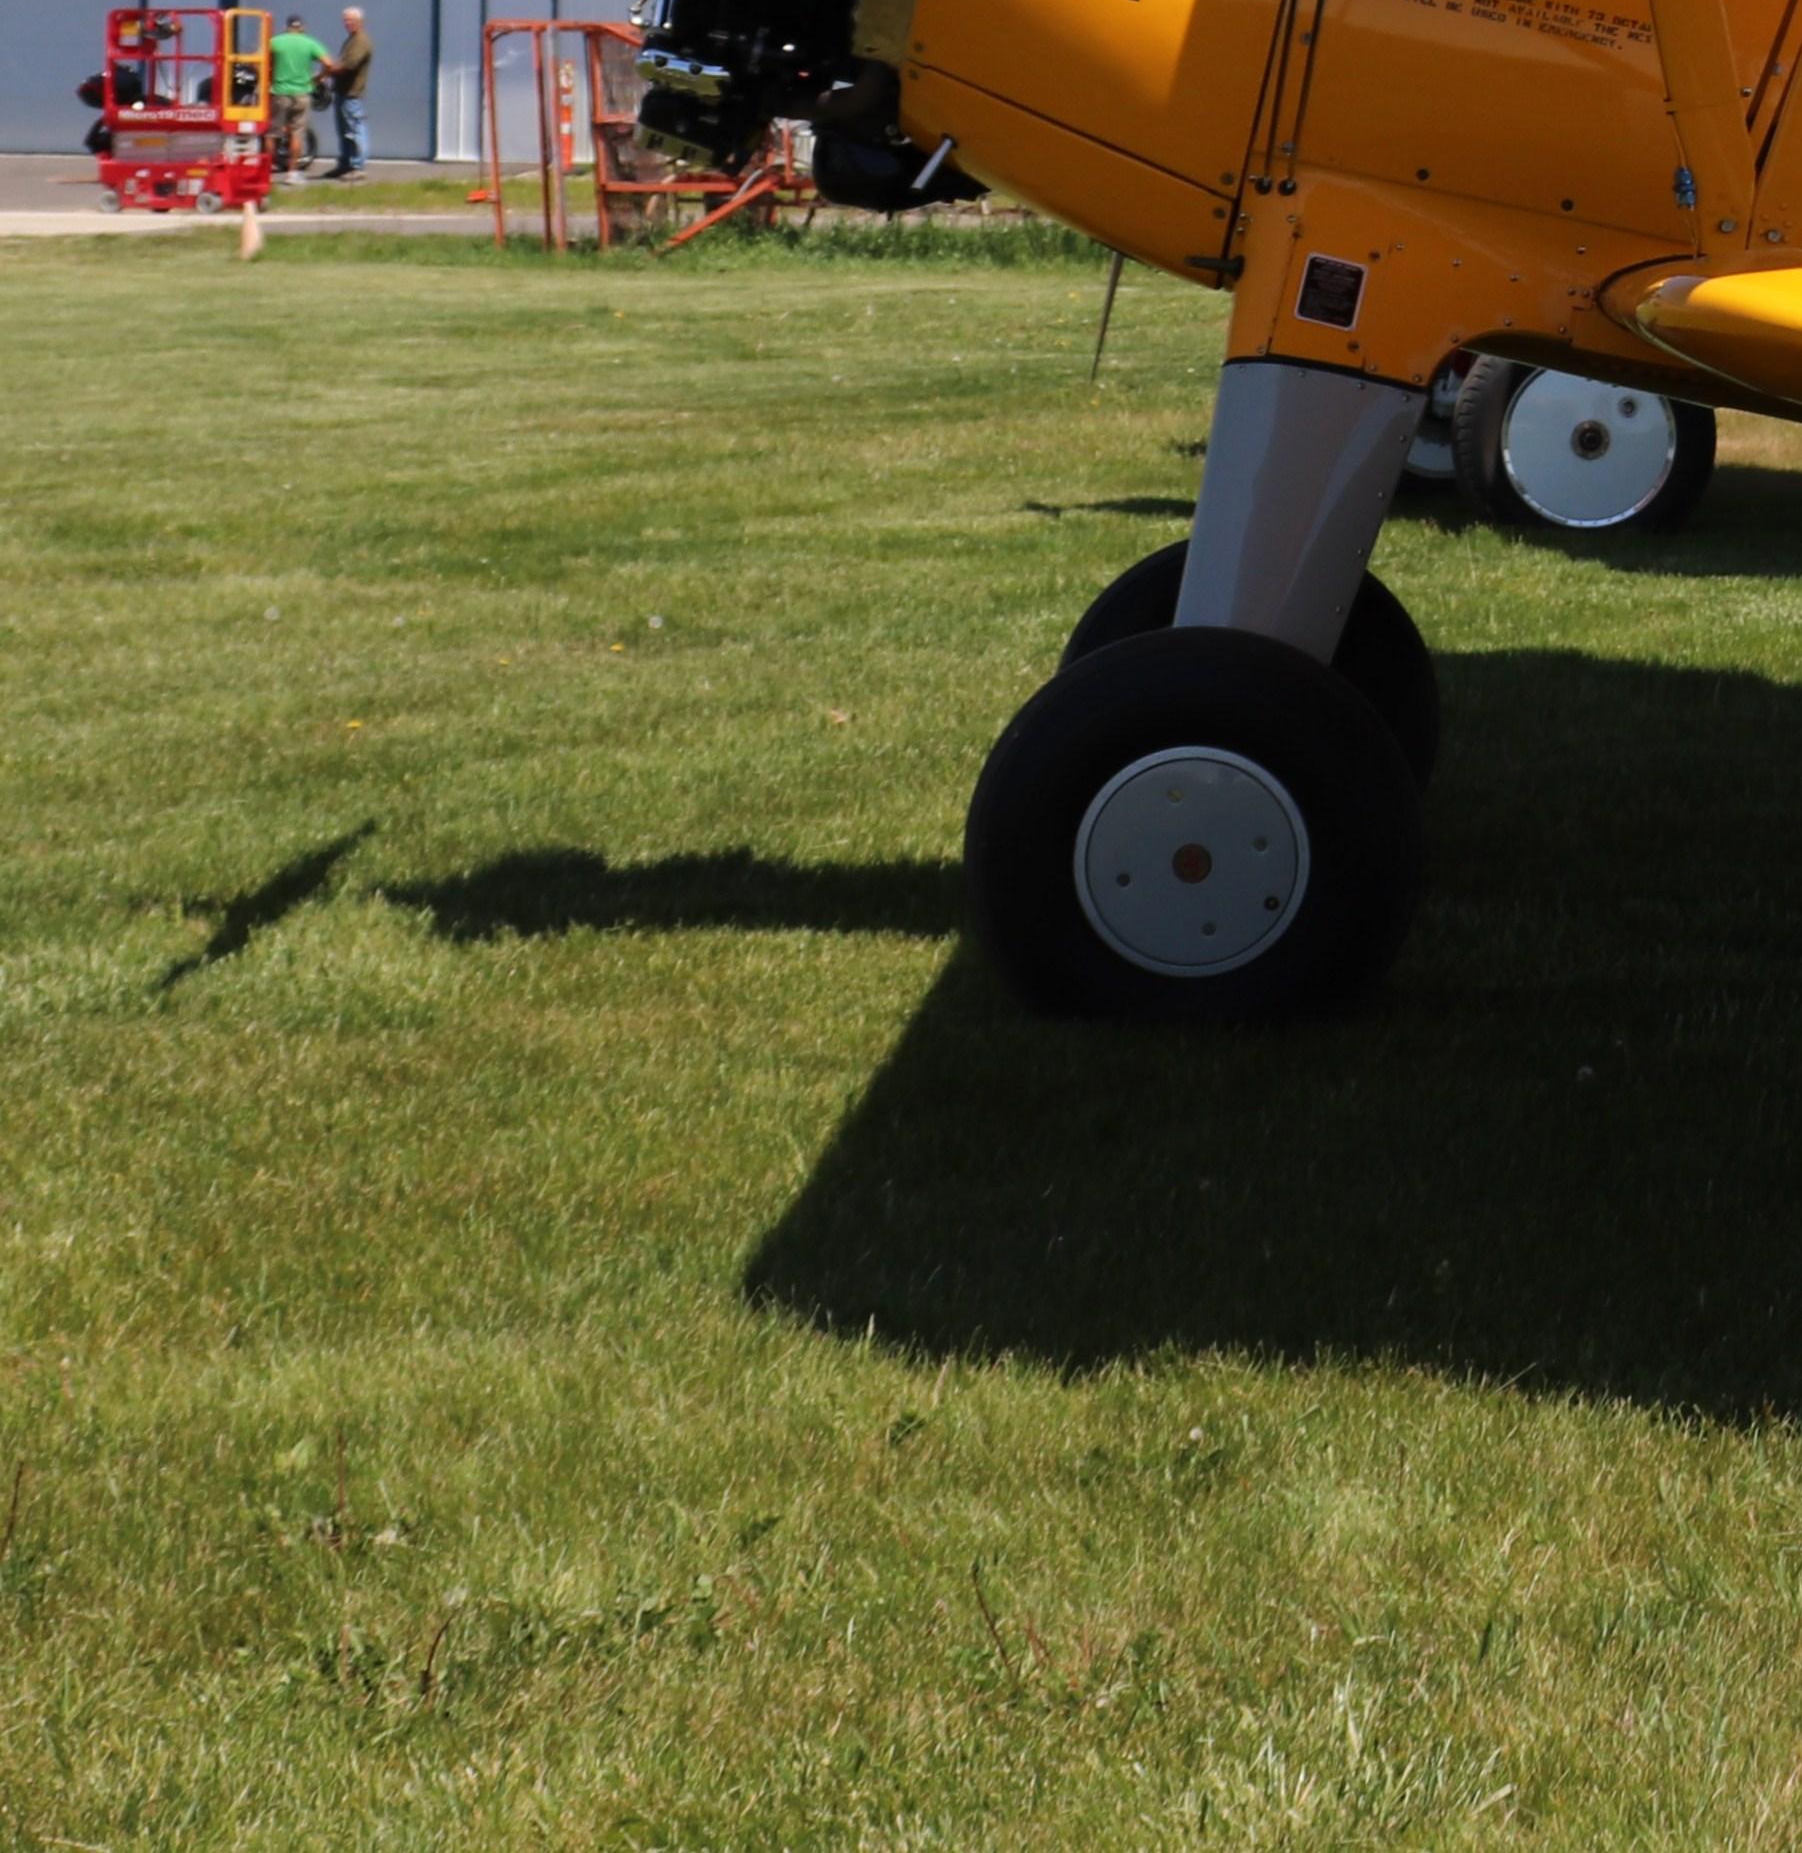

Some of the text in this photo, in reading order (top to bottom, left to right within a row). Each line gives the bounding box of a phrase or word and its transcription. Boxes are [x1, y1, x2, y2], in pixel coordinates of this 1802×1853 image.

[1545, 0, 1580, 16] WITH
[1472, 6, 1507, 23] USED
[1516, 17, 1532, 30] IN
[1594, 21, 1619, 37] THE
